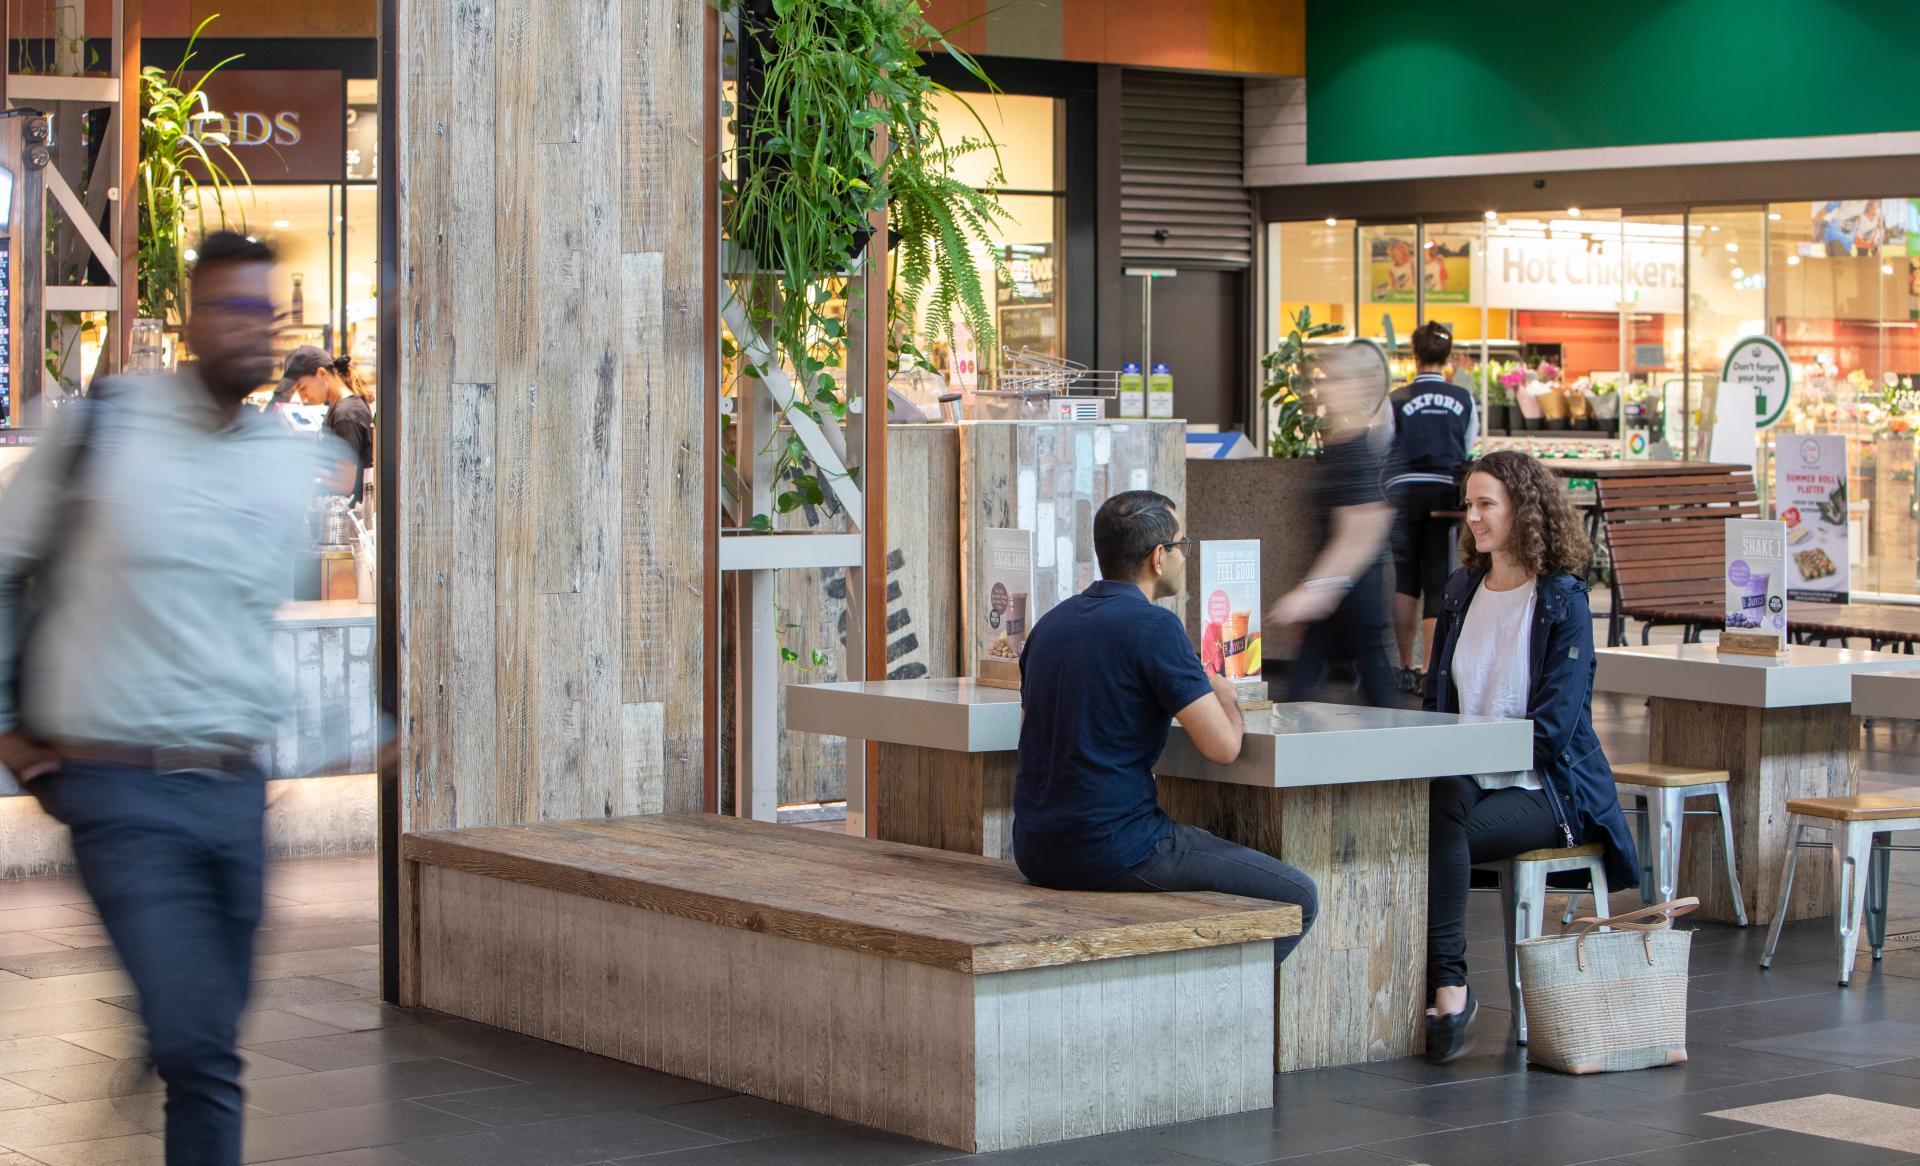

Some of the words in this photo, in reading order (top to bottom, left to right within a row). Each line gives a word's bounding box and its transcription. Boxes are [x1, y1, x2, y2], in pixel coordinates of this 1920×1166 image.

[1502, 248, 1556, 285] Hot
[1733, 362, 1755, 371] Don't
[1756, 362, 1780, 374] forget
[1738, 375, 1754, 384] your
[1756, 374, 1775, 384] bags
[1402, 393, 1464, 416] OXFORD
[1786, 473, 1815, 484] SUMMER
[1818, 474, 1836, 485] ROLL
[1797, 485, 1825, 494] PLATTER
[1743, 538, 1774, 557] SHAKE
[1217, 563, 1234, 581] FEEL
[1235, 562, 1255, 580] GOOD
